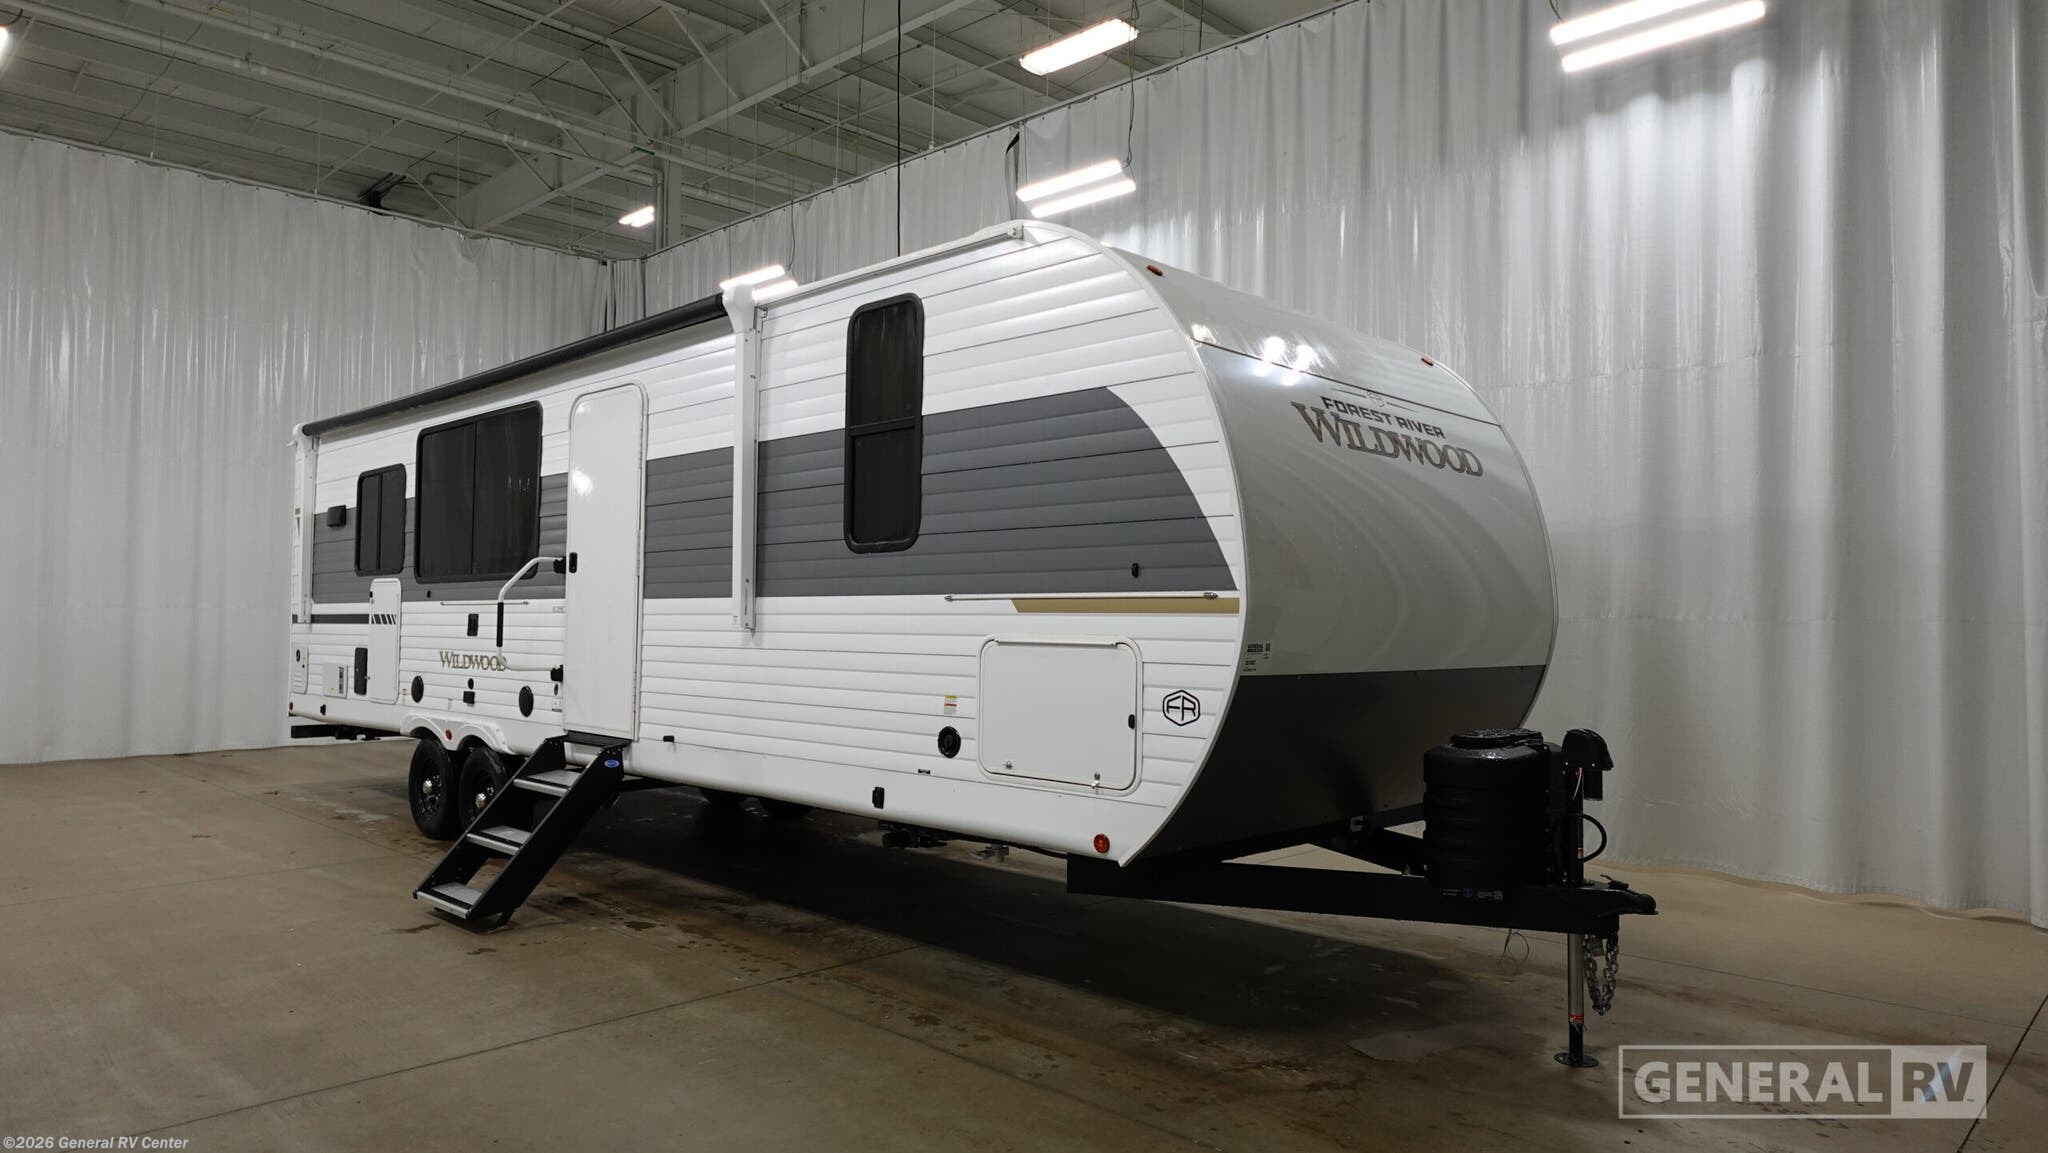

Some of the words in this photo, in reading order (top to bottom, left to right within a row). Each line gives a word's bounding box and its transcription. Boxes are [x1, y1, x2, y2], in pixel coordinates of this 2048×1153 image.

[1290, 400, 1484, 477] WILDWOOD
[1320, 395, 1393, 425] FOREST
[1394, 415, 1446, 439] RIVER
